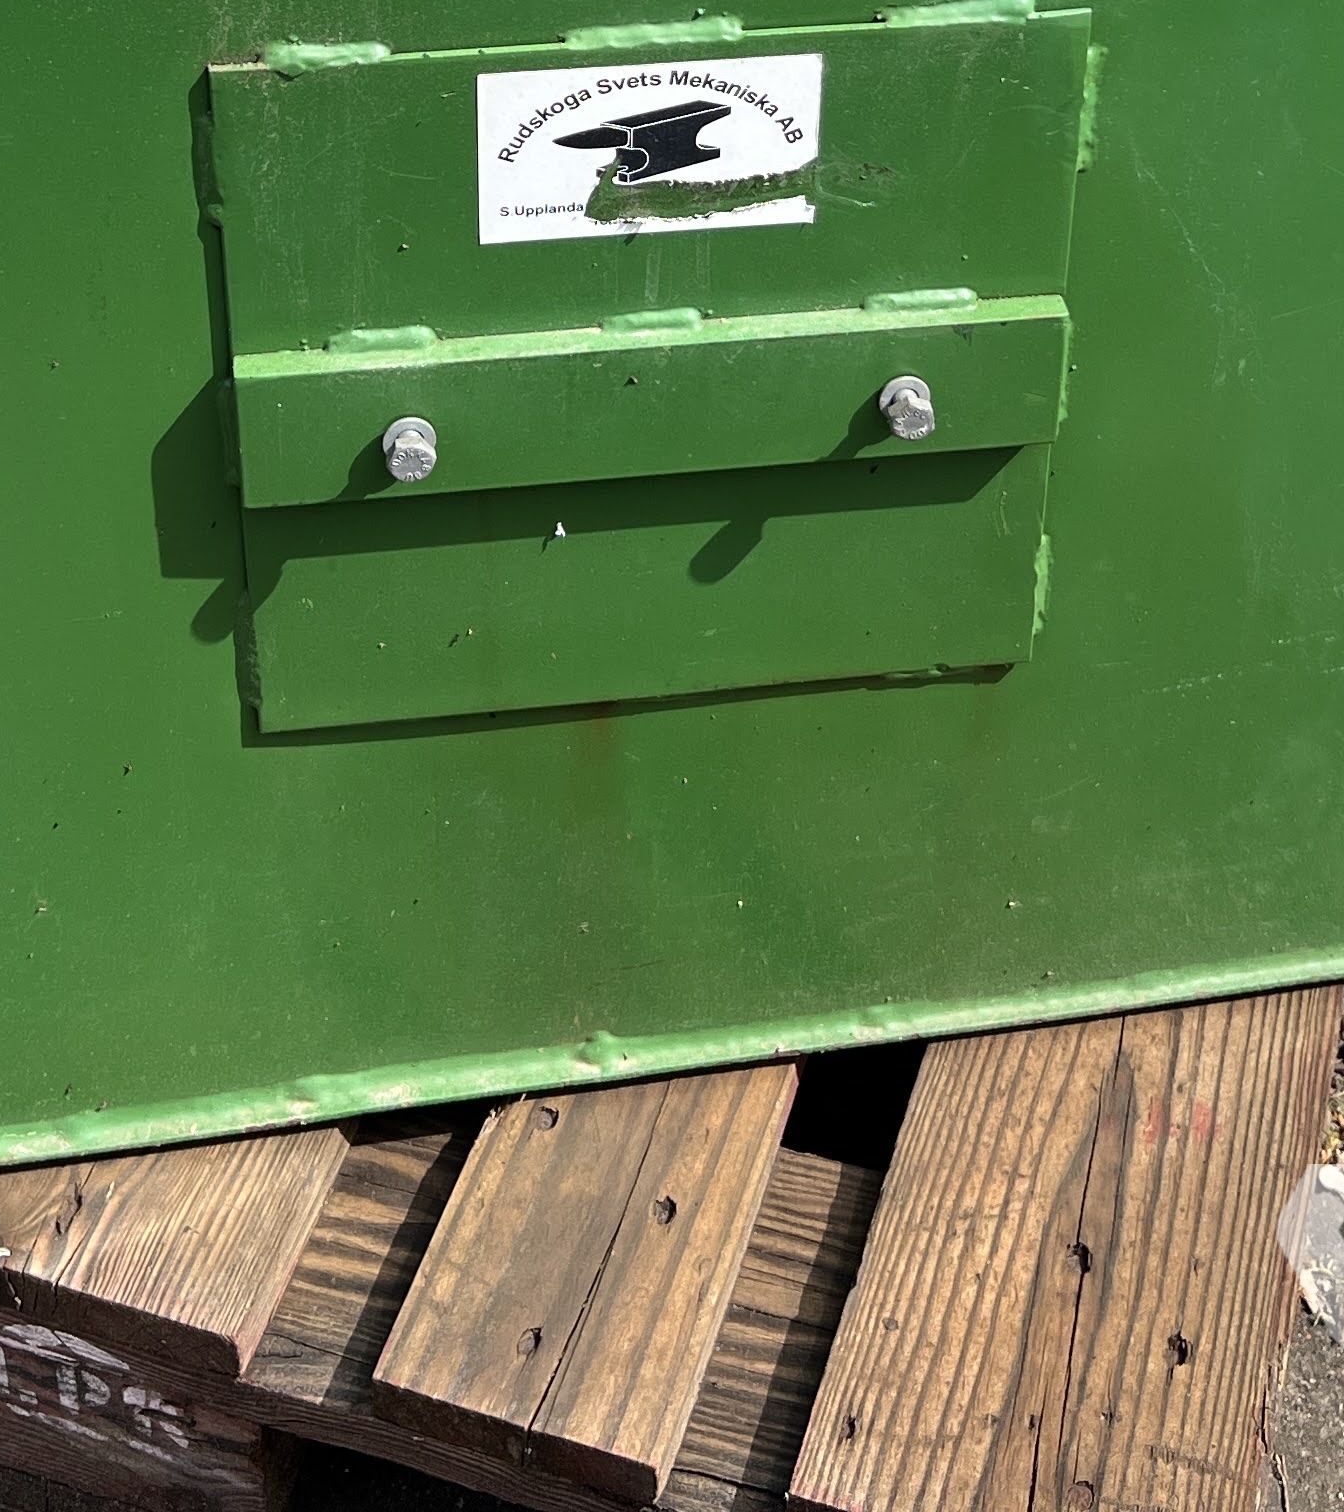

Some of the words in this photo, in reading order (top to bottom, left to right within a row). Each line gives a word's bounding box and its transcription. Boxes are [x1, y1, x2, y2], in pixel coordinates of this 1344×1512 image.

[497, 89, 592, 164] Rudskoga
[596, 72, 662, 95] Svets
[668, 70, 779, 119] Mekaniska
[775, 115, 805, 146] AB
